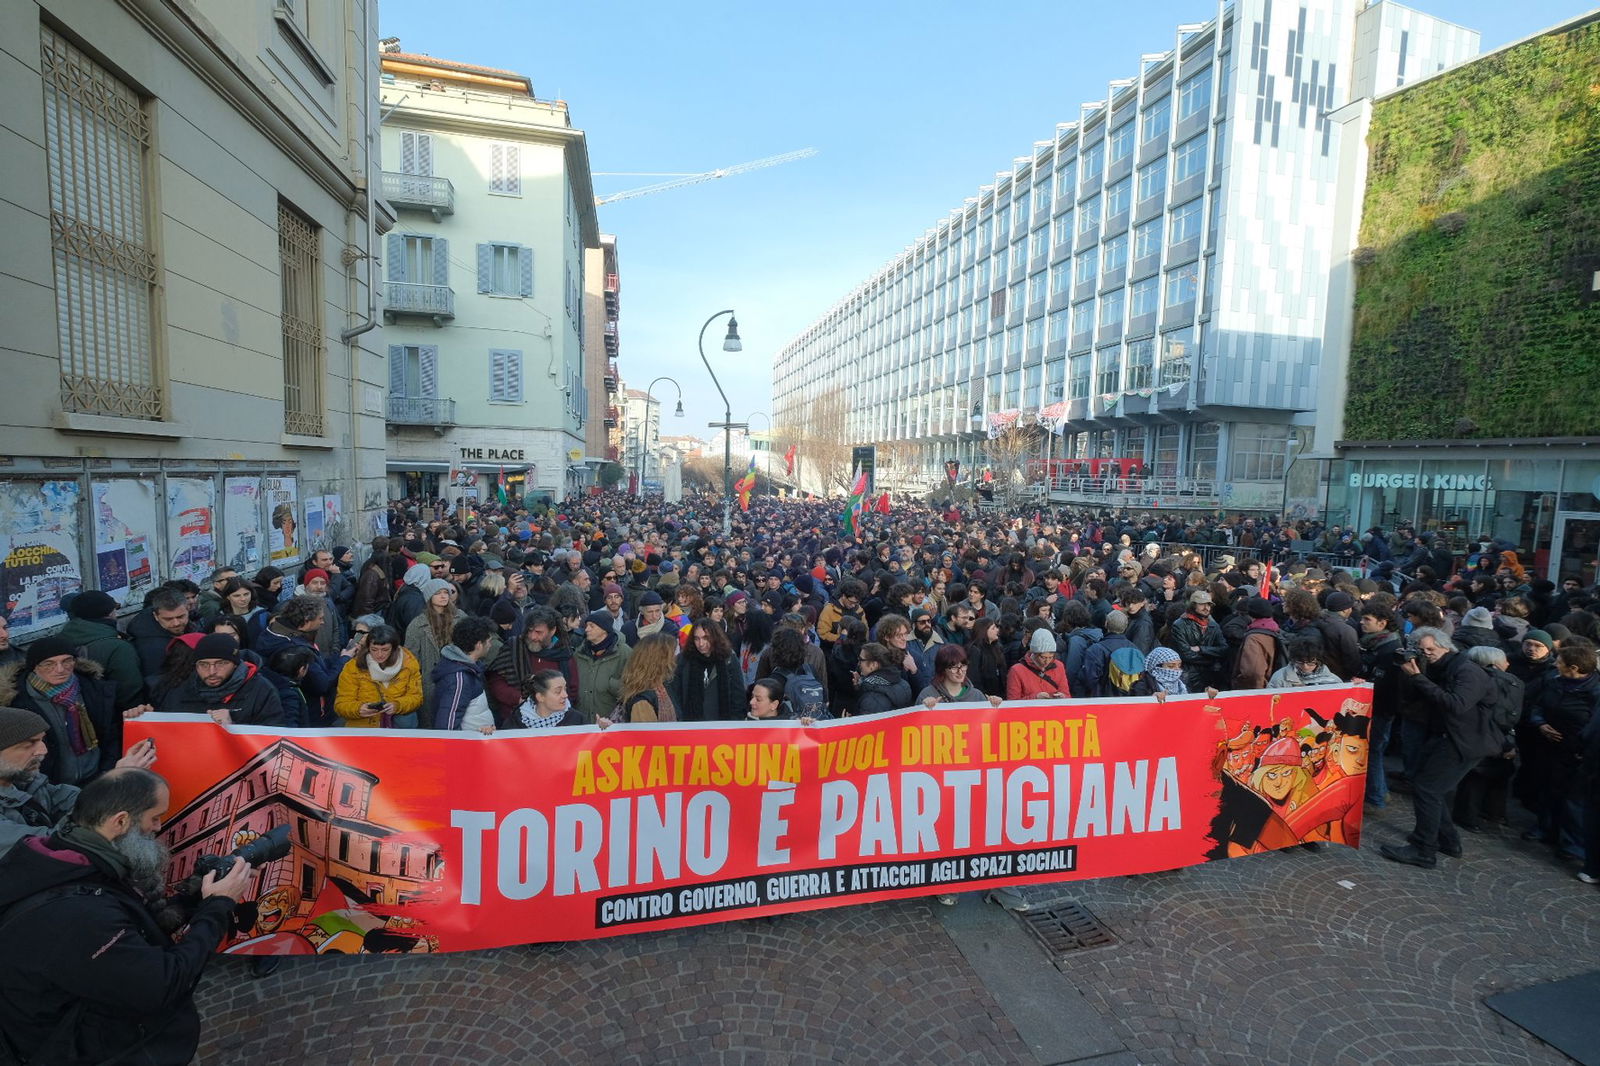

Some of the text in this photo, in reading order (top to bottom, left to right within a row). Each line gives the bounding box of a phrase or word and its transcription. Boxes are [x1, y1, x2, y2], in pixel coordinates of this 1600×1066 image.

[460, 447, 524, 460] THE PLACE
[1349, 473, 1491, 490] BURGER KING
[4, 553, 43, 568] TUTTO!
[572, 714, 1101, 796] ASKATASUNA VUOL DIRE LIBERTÀ
[450, 756, 1182, 906] TORINO È PARTIGIANA
[601, 849, 1073, 924] CONTRO GOVERNO, GUERRA E ATTACCHI AGLI SPAZI SOCIALI
